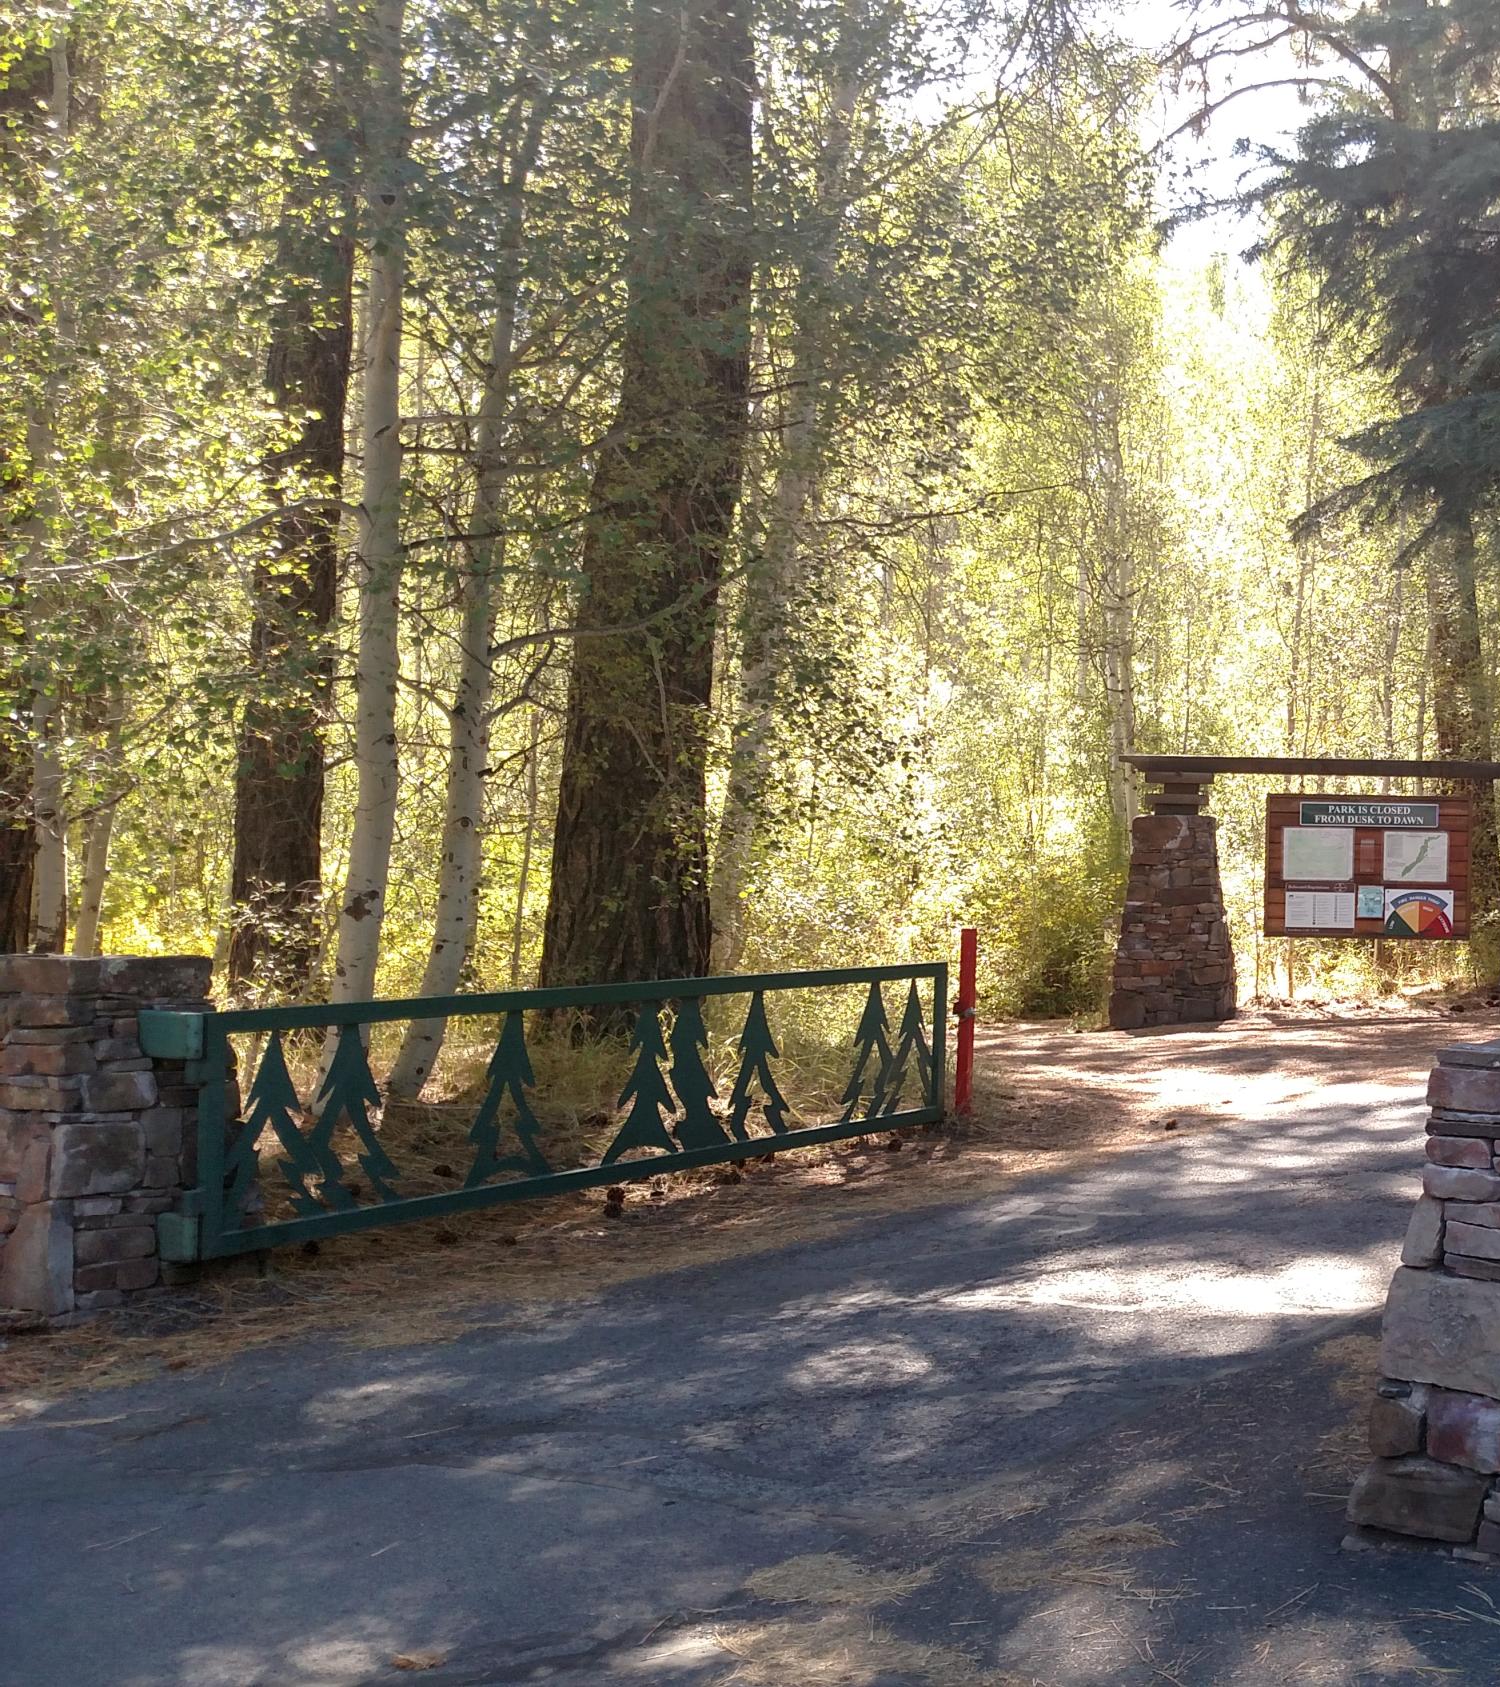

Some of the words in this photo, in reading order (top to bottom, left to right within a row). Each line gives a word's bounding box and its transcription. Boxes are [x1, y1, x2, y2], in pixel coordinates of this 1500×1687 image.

[1328, 805, 1356, 814] PARK
[1358, 806, 1368, 814] IS
[1370, 806, 1411, 815] CLOSED
[1314, 815, 1345, 824] FROM
[1347, 815, 1375, 824] DUSK
[1377, 816, 1391, 824] TO
[1393, 816, 1424, 825] DAWN
